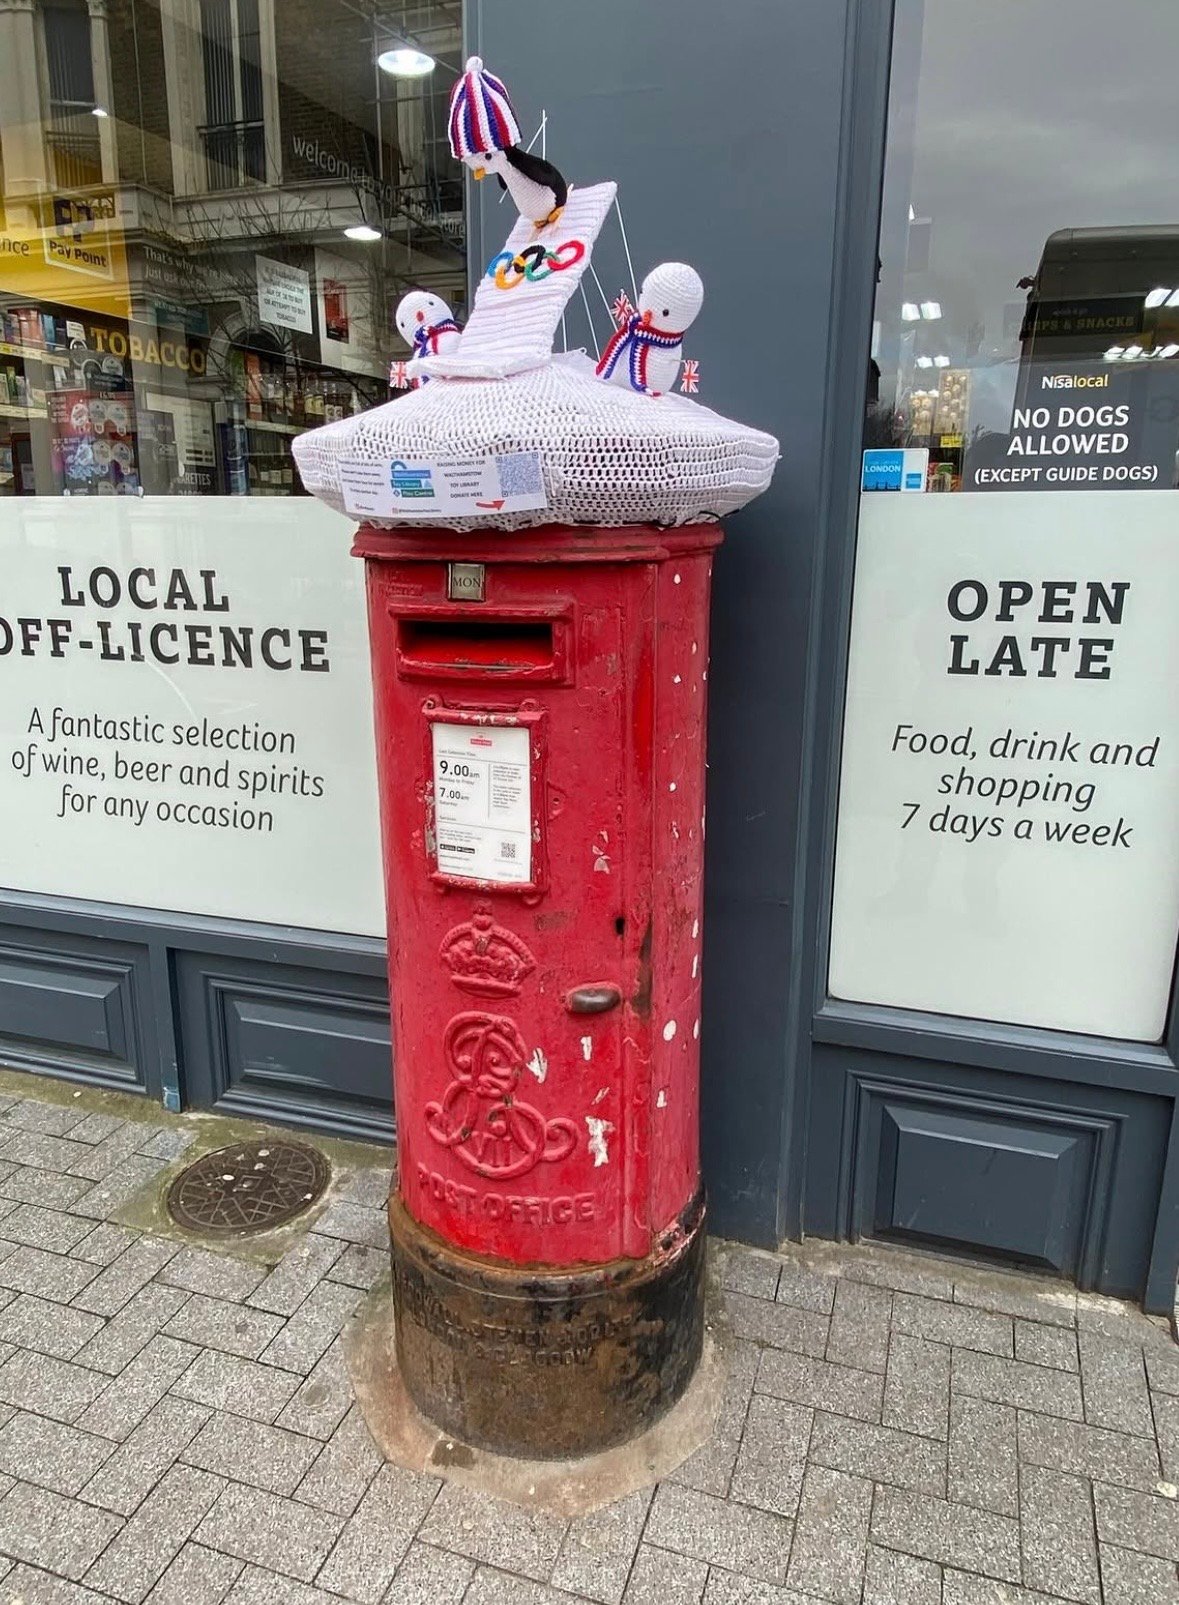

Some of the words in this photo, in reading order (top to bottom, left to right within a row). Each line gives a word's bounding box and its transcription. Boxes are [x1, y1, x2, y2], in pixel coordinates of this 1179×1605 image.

[143, 246, 174, 265] That's
[91, 327, 207, 373] TOBACCO
[1013, 408, 1050, 429] NO
[1057, 405, 1130, 427] DOGS
[1007, 433, 1129, 456] ALLOWED
[865, 465, 900, 473] LONDON
[974, 467, 1042, 484] (EXCEPT
[1046, 466, 1100, 483] GUIDE
[1103, 465, 1158, 482] DOGS)
[57, 566, 230, 612] LOCAL
[452, 578, 482, 588] MON
[947, 579, 1131, 624] OPEN
[947, 635, 1114, 680] LATE
[27, 707, 44, 734] A
[47, 707, 165, 743] fantastic
[172, 717, 296, 753] selection
[891, 724, 977, 761] Food,
[989, 728, 1082, 763] drink
[1089, 737, 1161, 767] and
[11, 744, 37, 777] of
[42, 747, 106, 782] wine,
[114, 751, 173, 782] beer
[179, 760, 230, 789] and
[237, 764, 325, 799] spirits
[439, 760, 480, 779] 9.00am
[937, 766, 1096, 812] shopping
[57, 784, 97, 818] for
[104, 796, 149, 826] any
[156, 801, 274, 832] occasion
[439, 787, 470, 801] 7.00am
[901, 803, 921, 830] 7
[929, 804, 1005, 843] days
[1013, 818, 1033, 840] a
[1045, 818, 1134, 848] week
[416, 1161, 478, 1216] POST
[483, 1192, 595, 1225] OFFICE
